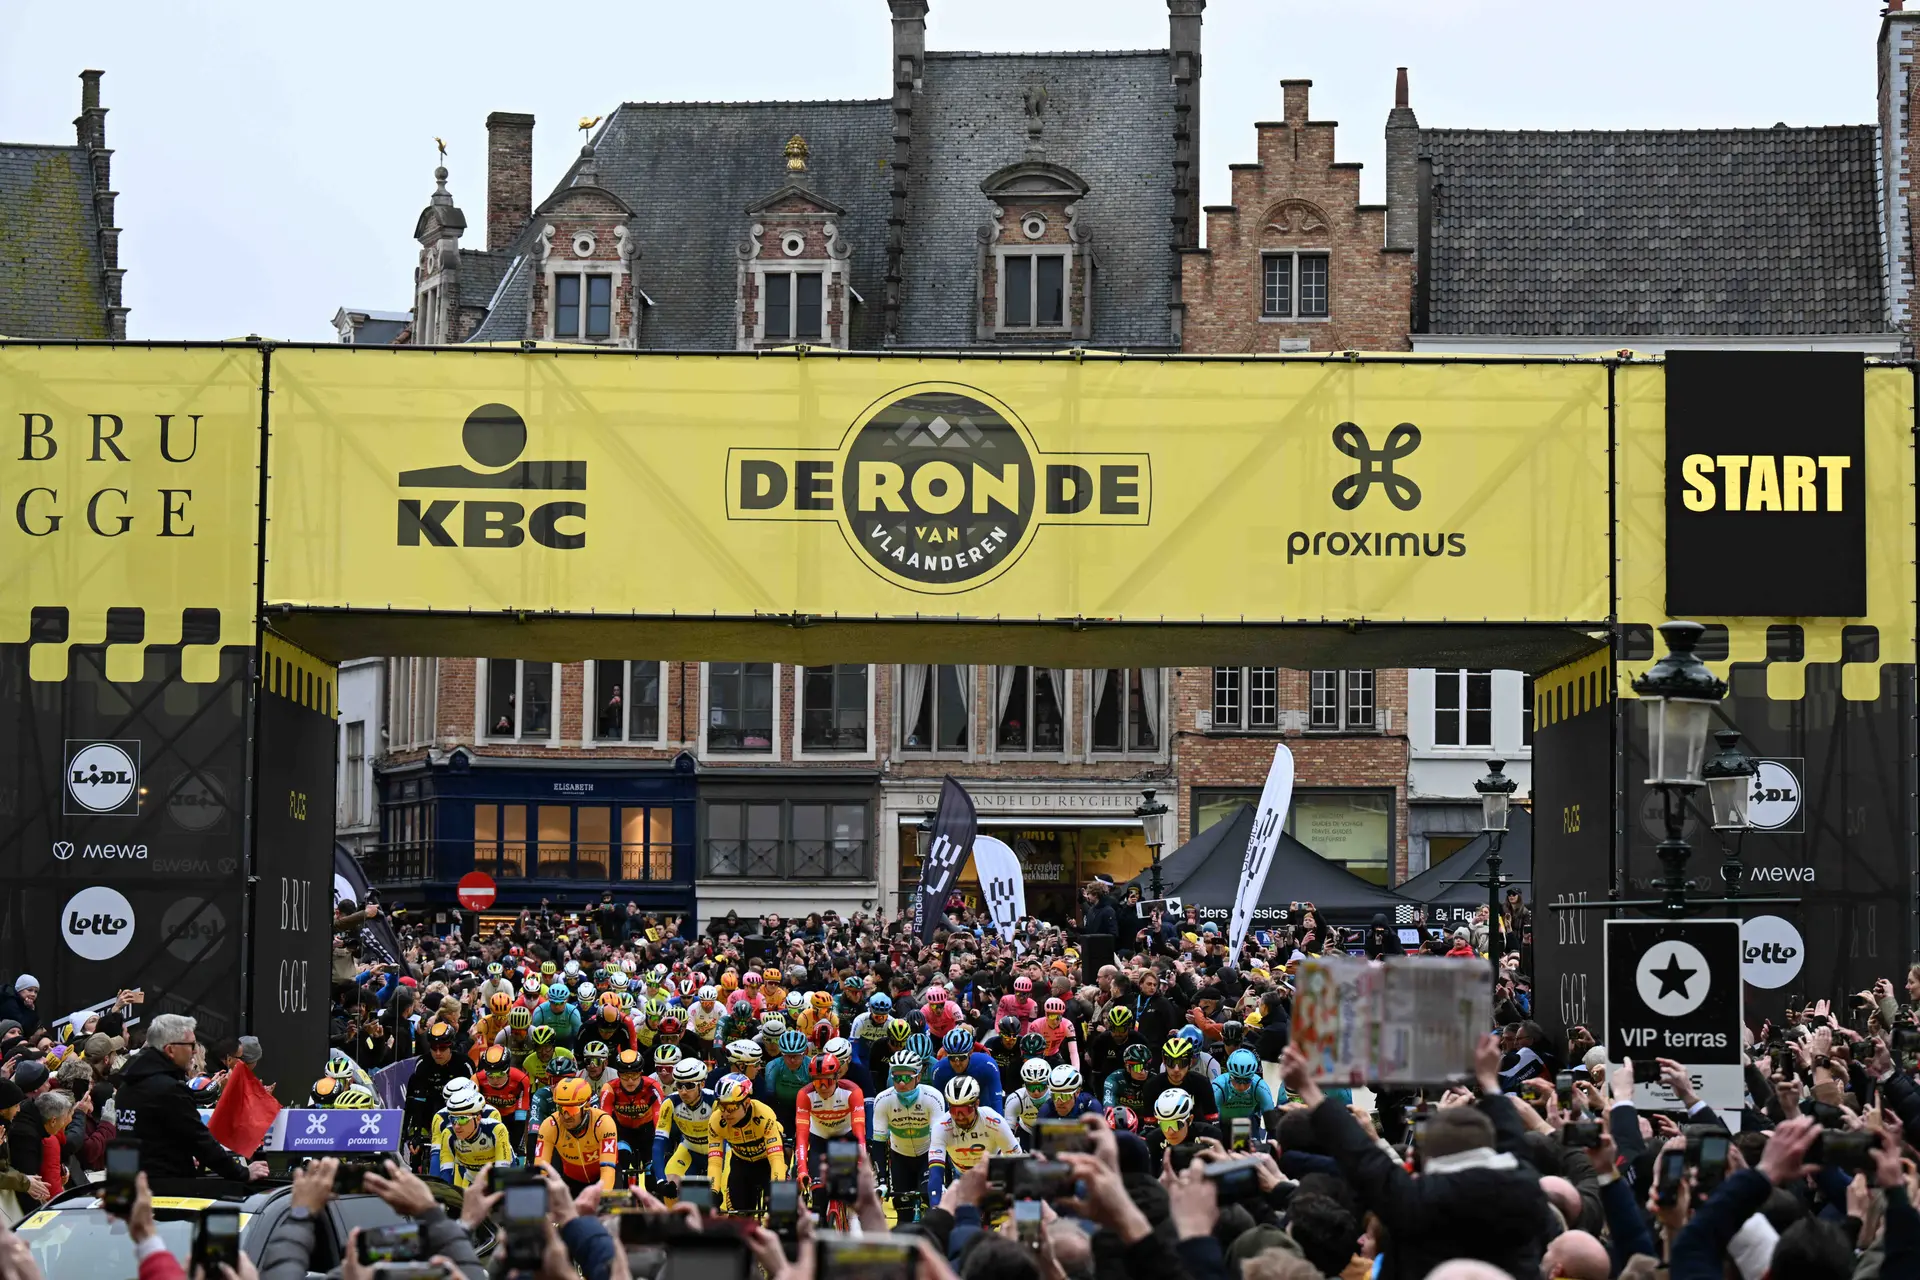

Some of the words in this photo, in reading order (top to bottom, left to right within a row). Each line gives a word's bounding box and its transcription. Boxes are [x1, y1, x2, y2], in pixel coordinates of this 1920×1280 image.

[1682, 453, 1851, 512] START
[397, 500, 586, 549] KBC
[915, 527, 958, 543] VAN
[871, 523, 1008, 571] VLAANDEREN
[1286, 531, 1467, 564] proximus
[1031, 794, 1051, 806] DE
[1058, 794, 1139, 807] REYGHERE
[1620, 1028, 1657, 1047] VIP
[1663, 1029, 1728, 1048] terras
[294, 1137, 334, 1145] proximus
[348, 1137, 388, 1145] proximus
